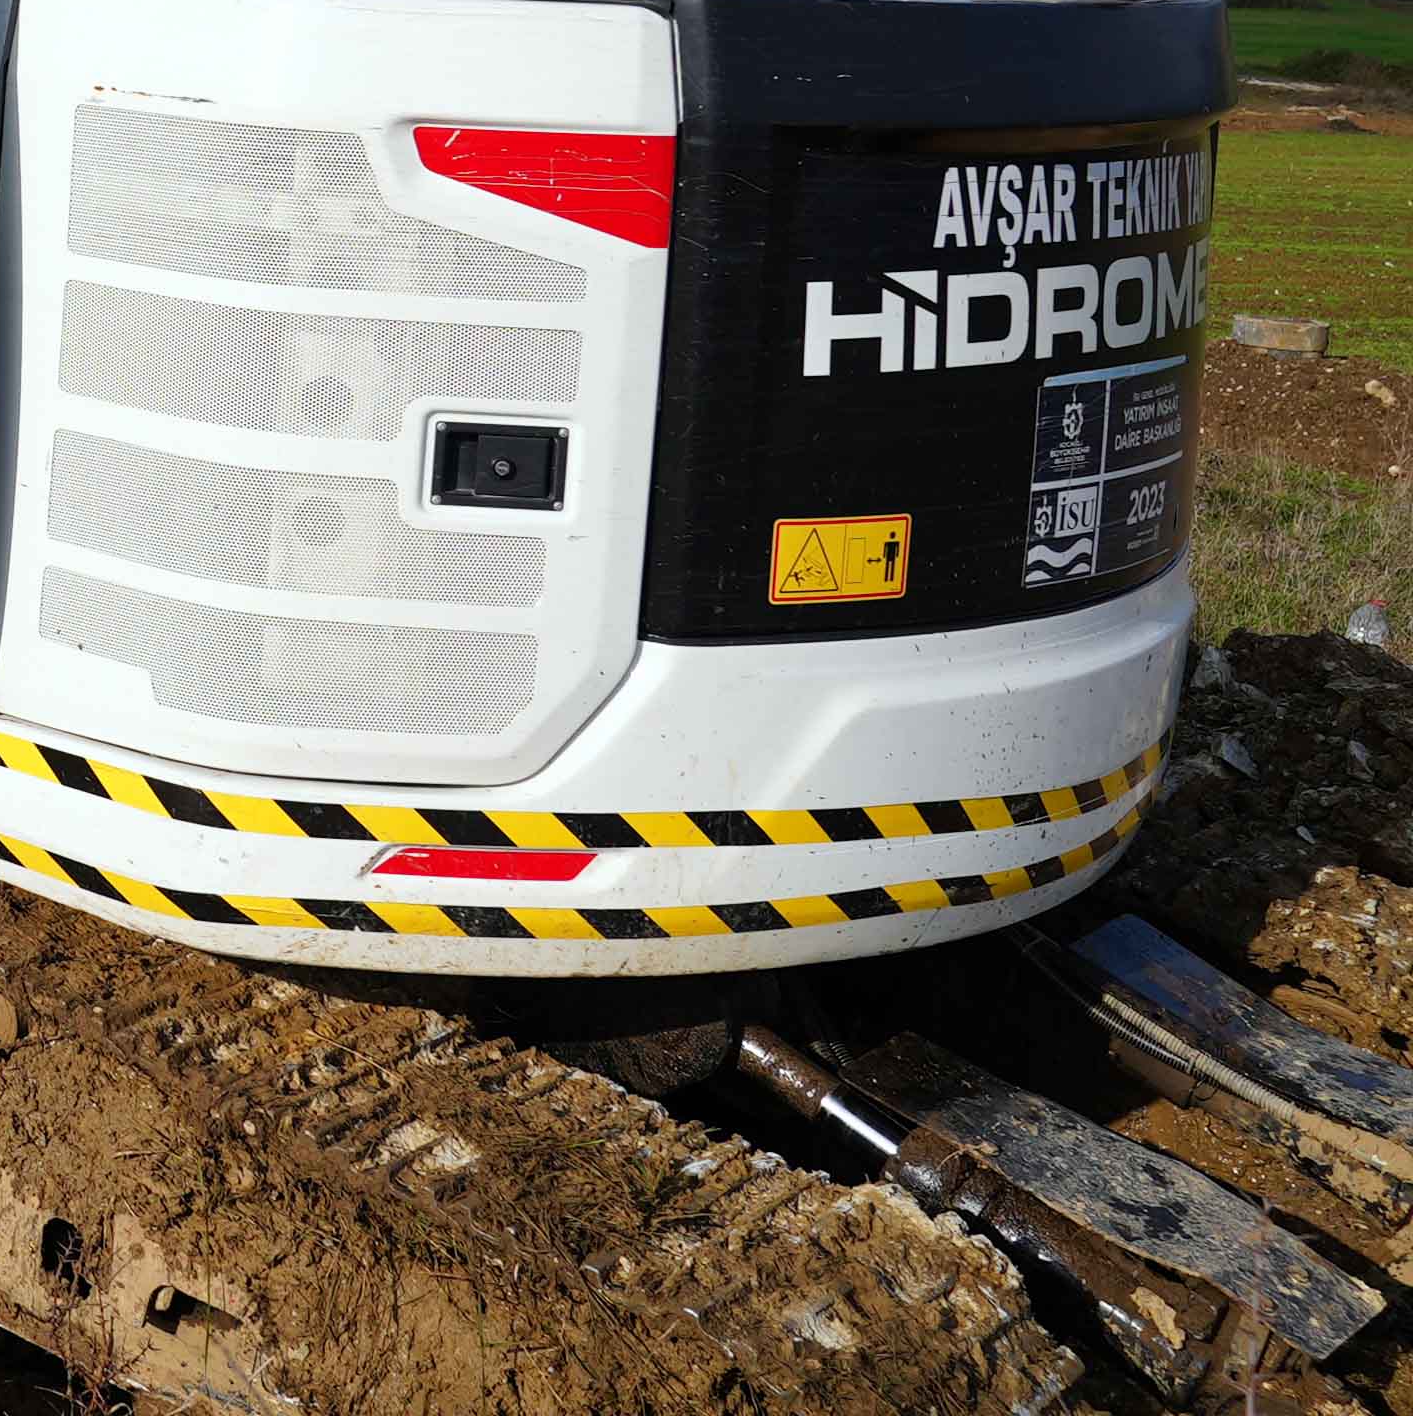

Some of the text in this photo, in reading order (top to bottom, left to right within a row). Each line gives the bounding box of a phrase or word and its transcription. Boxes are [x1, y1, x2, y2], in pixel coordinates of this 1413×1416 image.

[933, 164, 1077, 268] AVŞAR
[1086, 139, 1182, 240] TEKNİK
[1114, 425, 1142, 452] DAİRE
[1126, 480, 1166, 526] 2023
